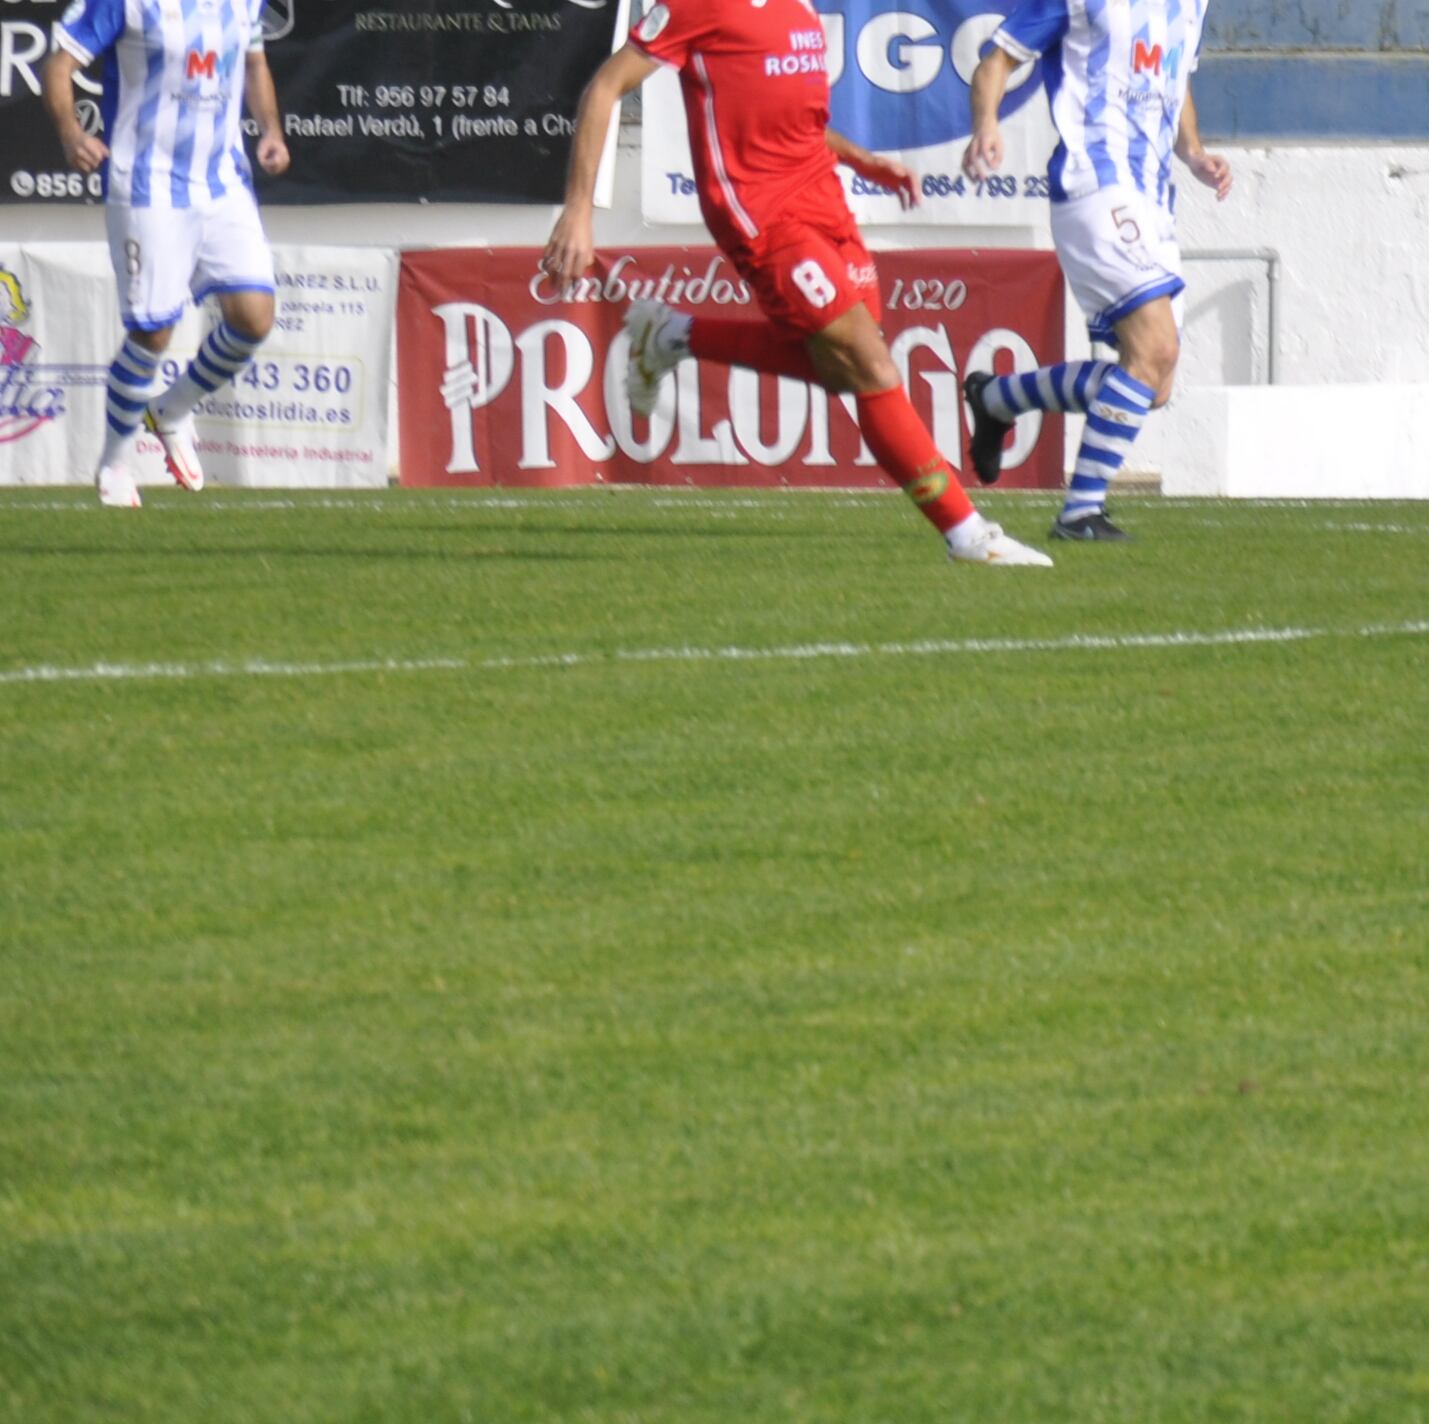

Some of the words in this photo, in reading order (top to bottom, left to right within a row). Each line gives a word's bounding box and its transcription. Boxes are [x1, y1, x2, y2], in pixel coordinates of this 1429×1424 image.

[354, 13, 483, 32] RESTAURANTE
[508, 14, 561, 32] TAPAS
[375, 84, 416, 107] 956
[419, 84, 447, 107] 97
[451, 84, 478, 107] 57
[483, 84, 511, 107] 84
[284, 114, 353, 137] Rafael
[431, 116, 443, 137] 1
[452, 114, 519, 141] (frente
[523, 120, 539, 137] a
[36, 174, 83, 197] 856
[1110, 206, 1141, 244] 5
[791, 259, 837, 309] 8
[886, 279, 967, 309] 1820
[293, 364, 352, 394] 360
